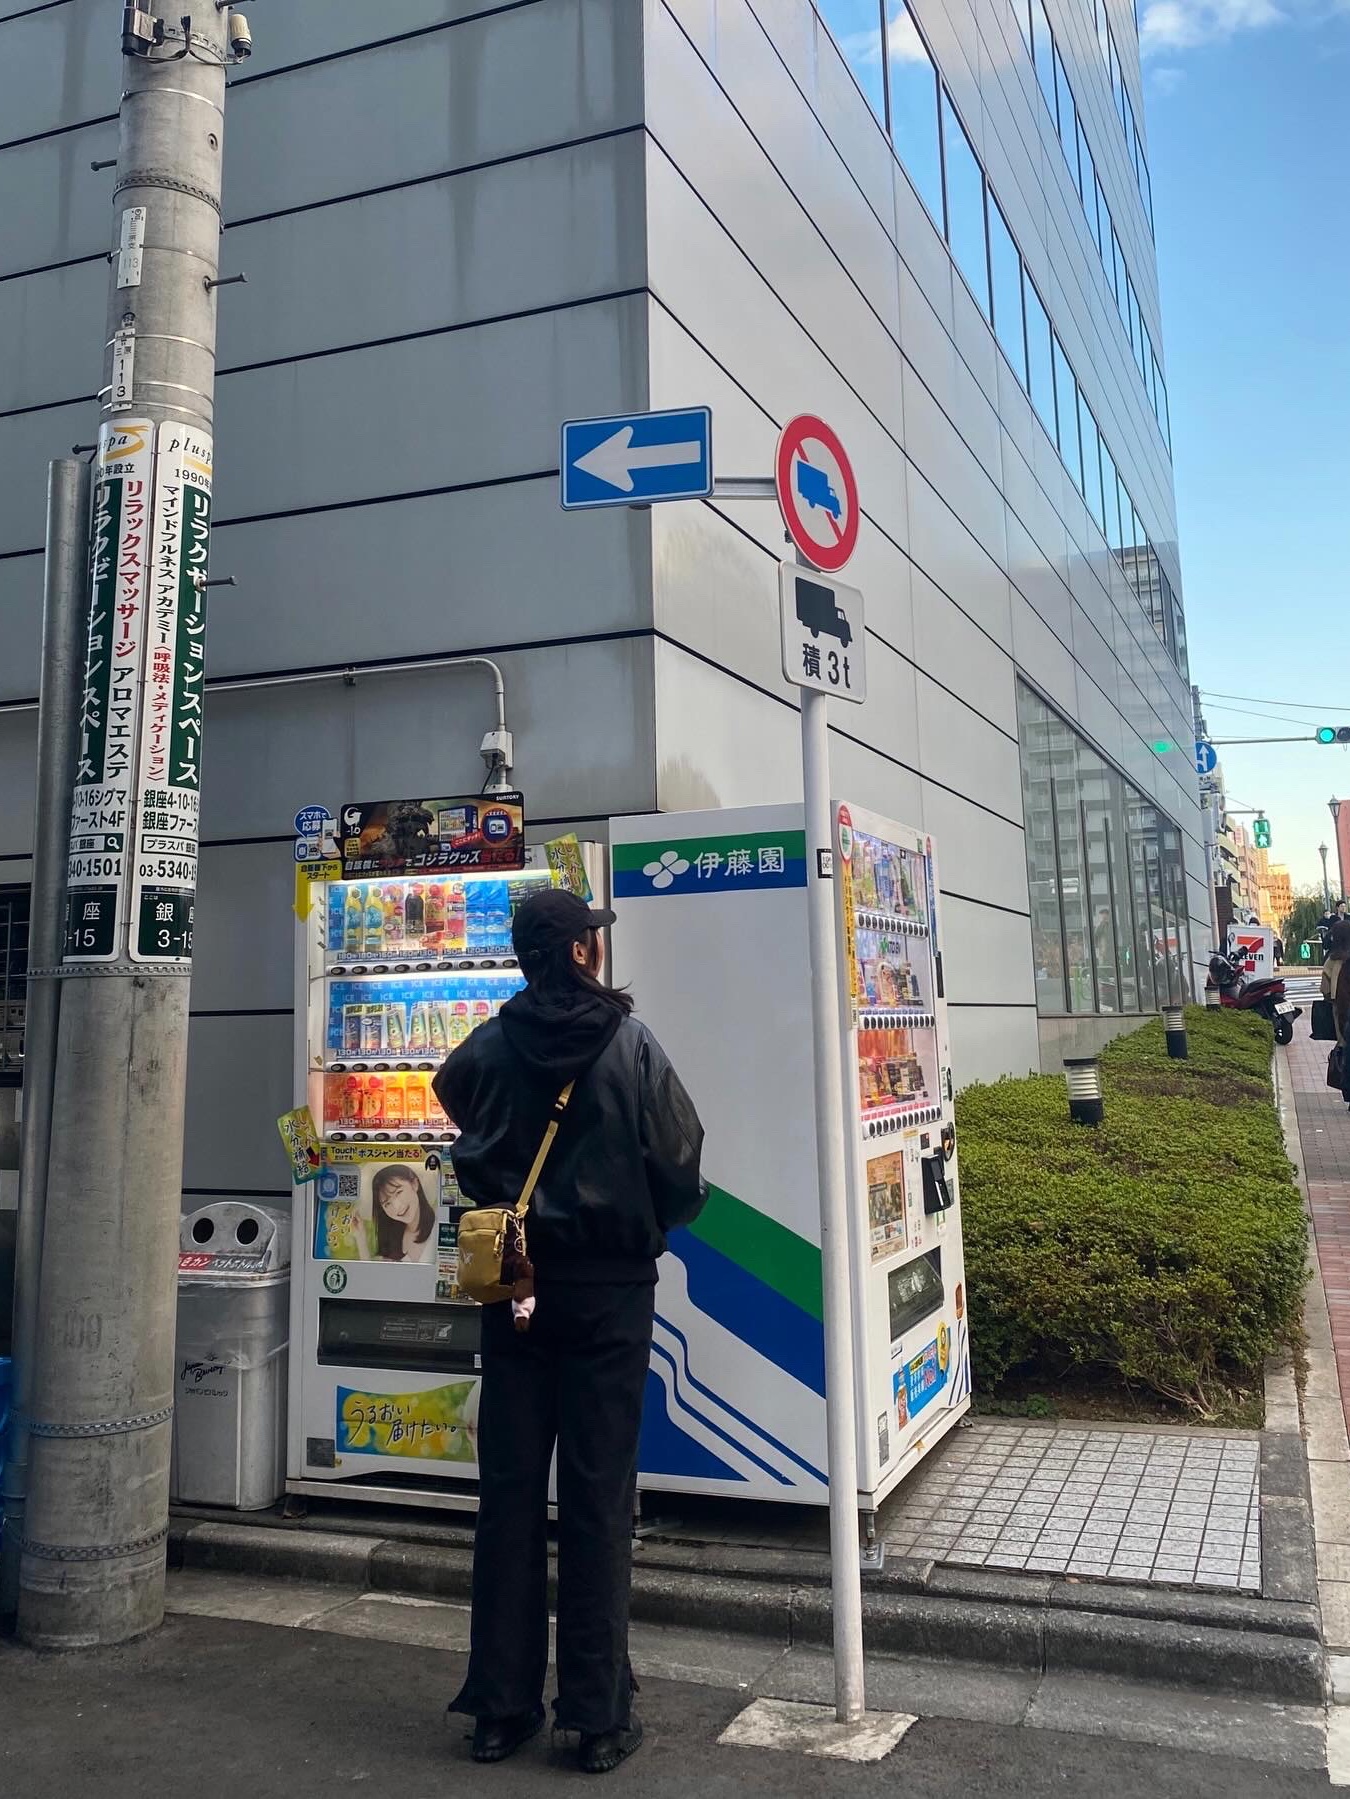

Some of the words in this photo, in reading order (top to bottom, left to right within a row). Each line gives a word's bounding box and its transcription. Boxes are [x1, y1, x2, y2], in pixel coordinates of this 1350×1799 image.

[116, 359, 126, 398] 113
[174, 468, 212, 490] 1990年
[157, 485, 180, 580] マインドフルネス
[115, 480, 144, 659] リラックスマッサージ
[106, 667, 135, 779] アロマエステ
[306, 872, 331, 881] スタート
[693, 845, 785, 880] 伊藤園
[347, 1400, 411, 1445] うるおい
[385, 1418, 458, 1447] 届けたい。
